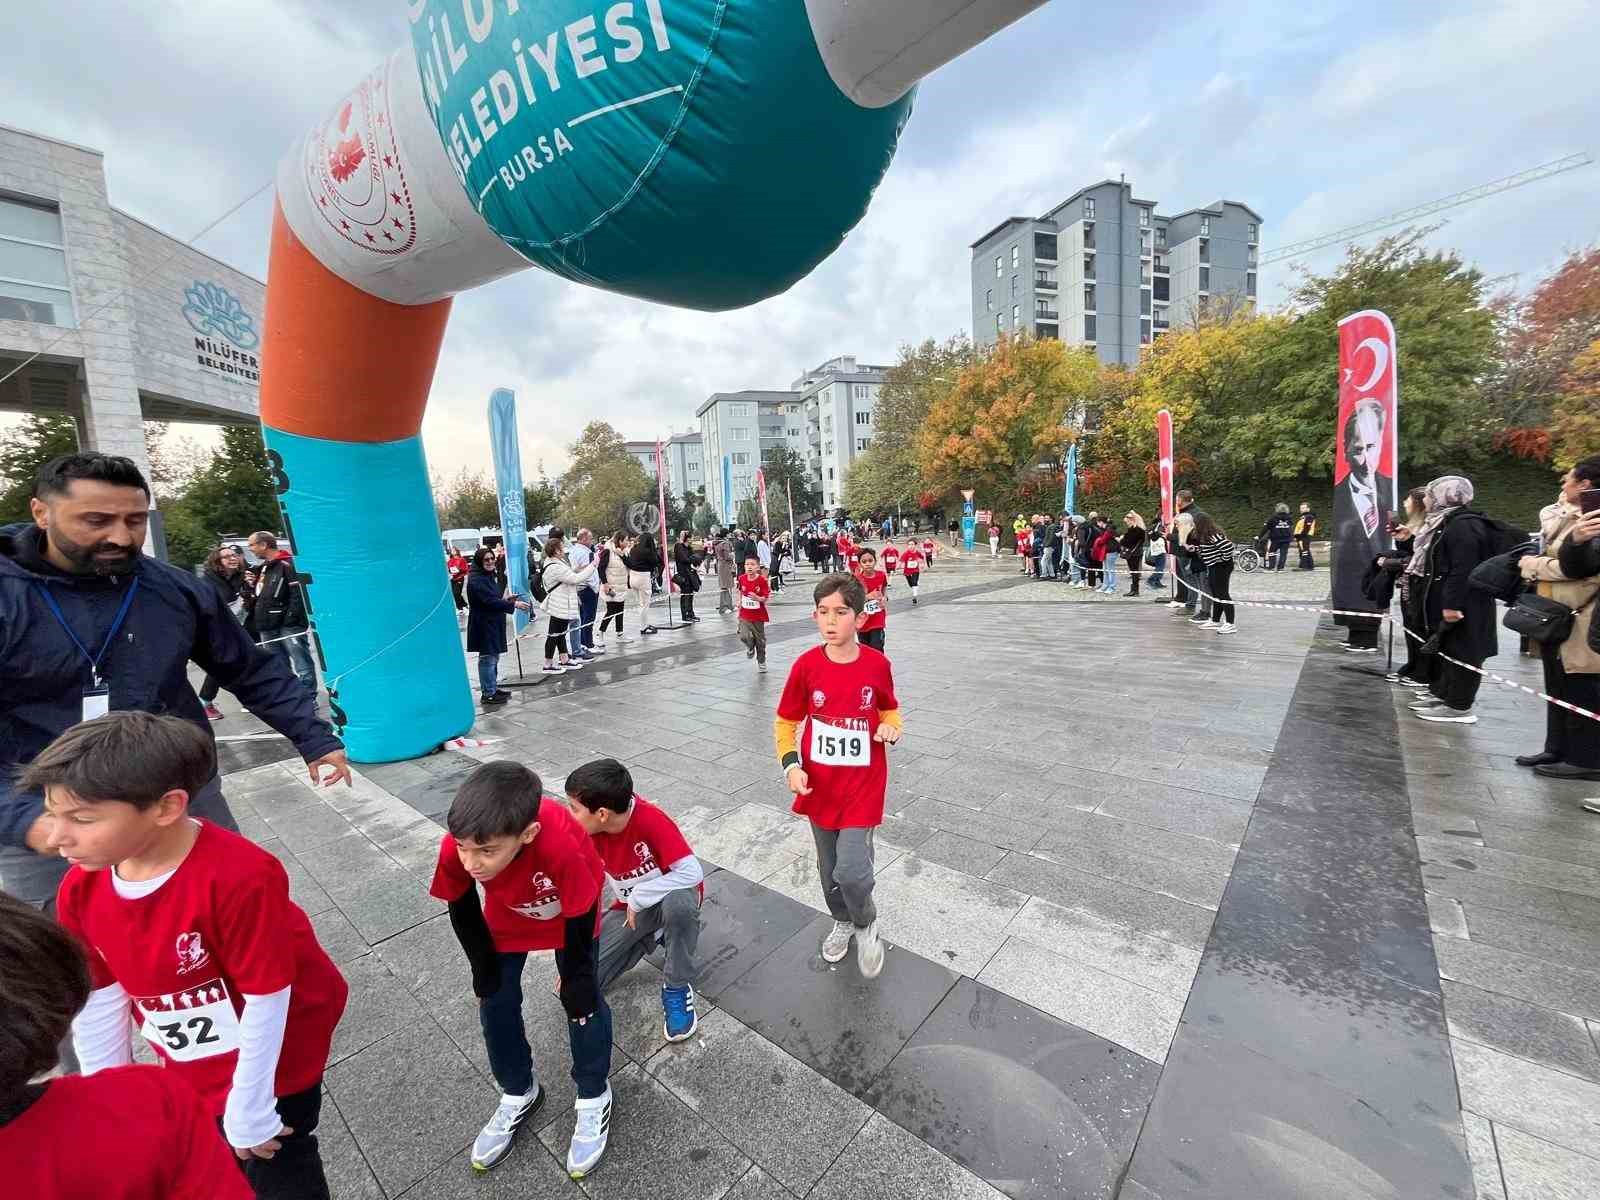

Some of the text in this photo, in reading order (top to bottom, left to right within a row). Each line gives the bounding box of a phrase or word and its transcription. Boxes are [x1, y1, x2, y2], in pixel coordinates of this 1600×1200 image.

[500, 127, 574, 190] BURSA
[194, 337, 258, 369] NİLÜFER
[817, 734, 861, 757] 1519
[157, 1016, 220, 1050] 32
